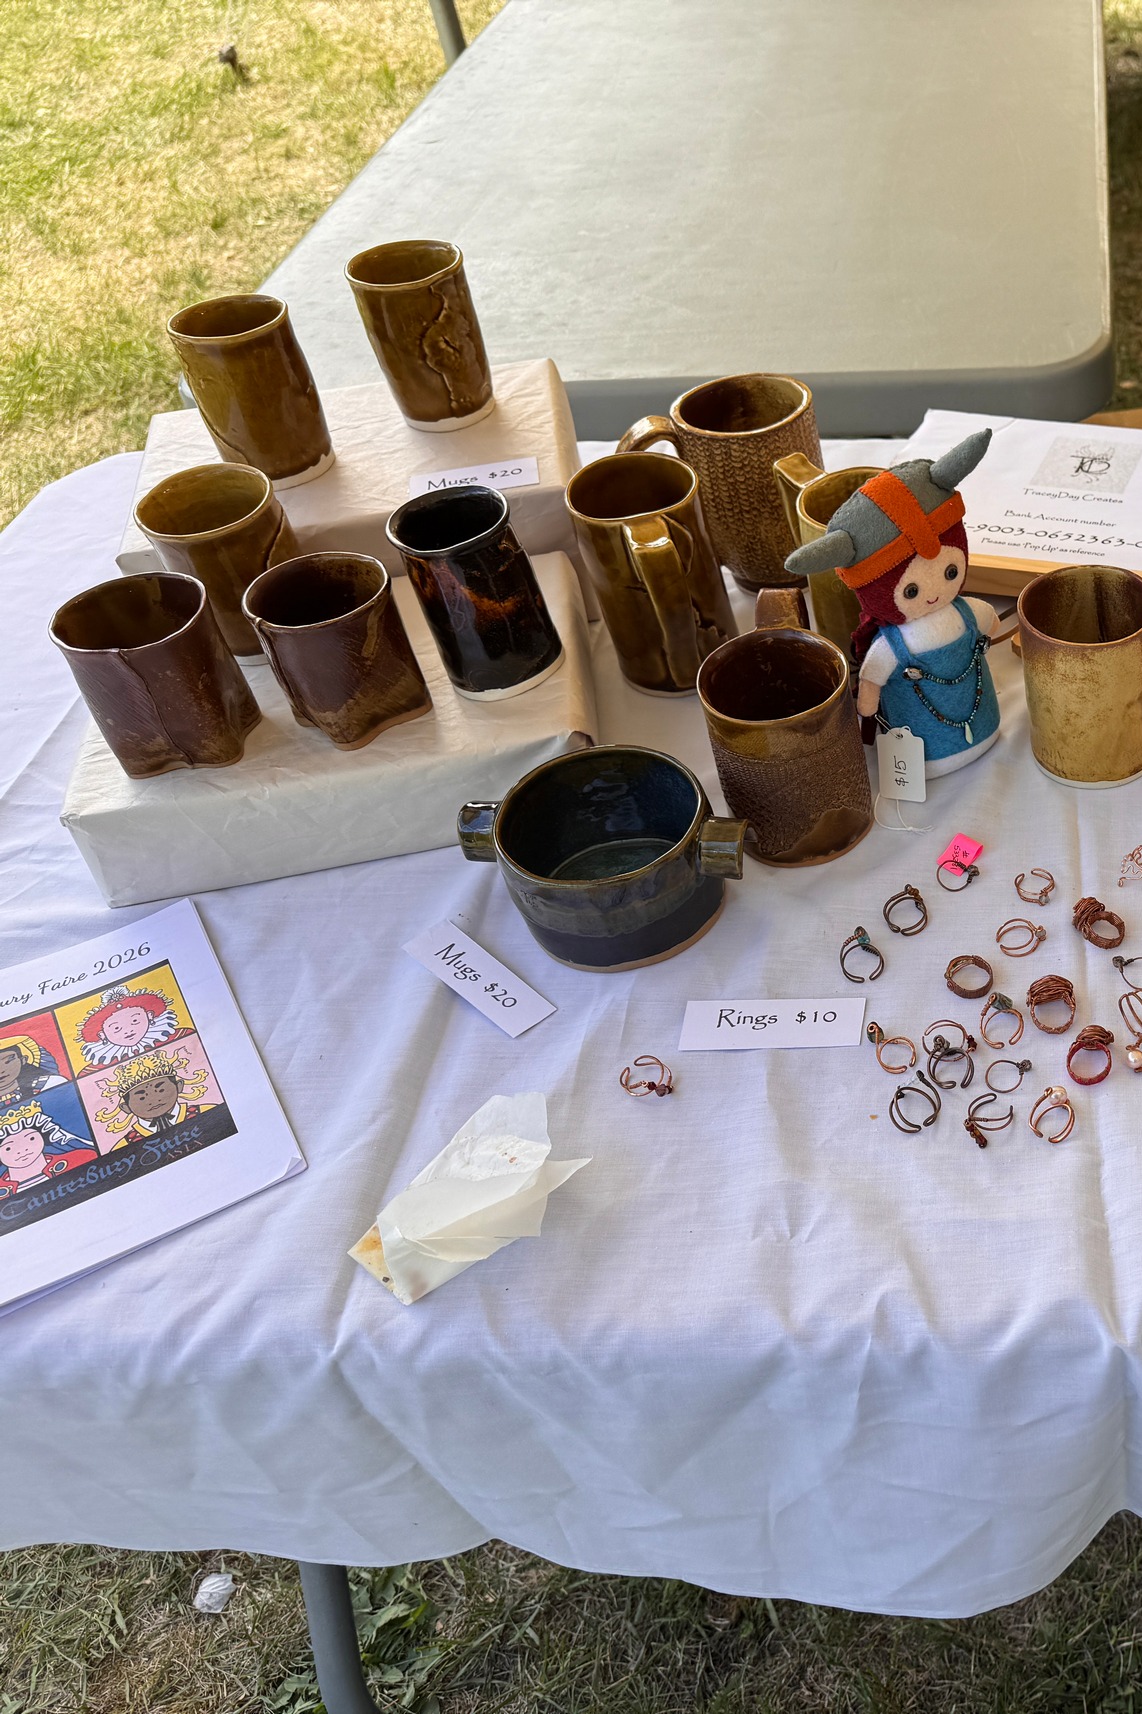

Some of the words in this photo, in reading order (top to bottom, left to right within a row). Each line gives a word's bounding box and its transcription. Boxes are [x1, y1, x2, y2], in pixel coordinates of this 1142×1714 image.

[427, 476, 479, 491] Mugs
[488, 467, 523, 479] $20
[1022, 487, 1080, 502] TraceyDay
[1081, 493, 1124, 504] Creates
[1004, 509, 1032, 519] Bank
[1033, 513, 1079, 524] Account
[1080, 519, 1117, 528] number
[981, 537, 1006, 546] Please
[1069, 547, 1106, 557] reference
[893, 755, 909, 787] $15
[37, 971, 88, 995] Faire
[92, 941, 152, 976] 2026
[433, 942, 482, 982] Mugs
[483, 982, 518, 1008] $20
[716, 1007, 779, 1030] Rings
[795, 1009, 838, 1025] $10
[140, 1124, 203, 1166] Faire
